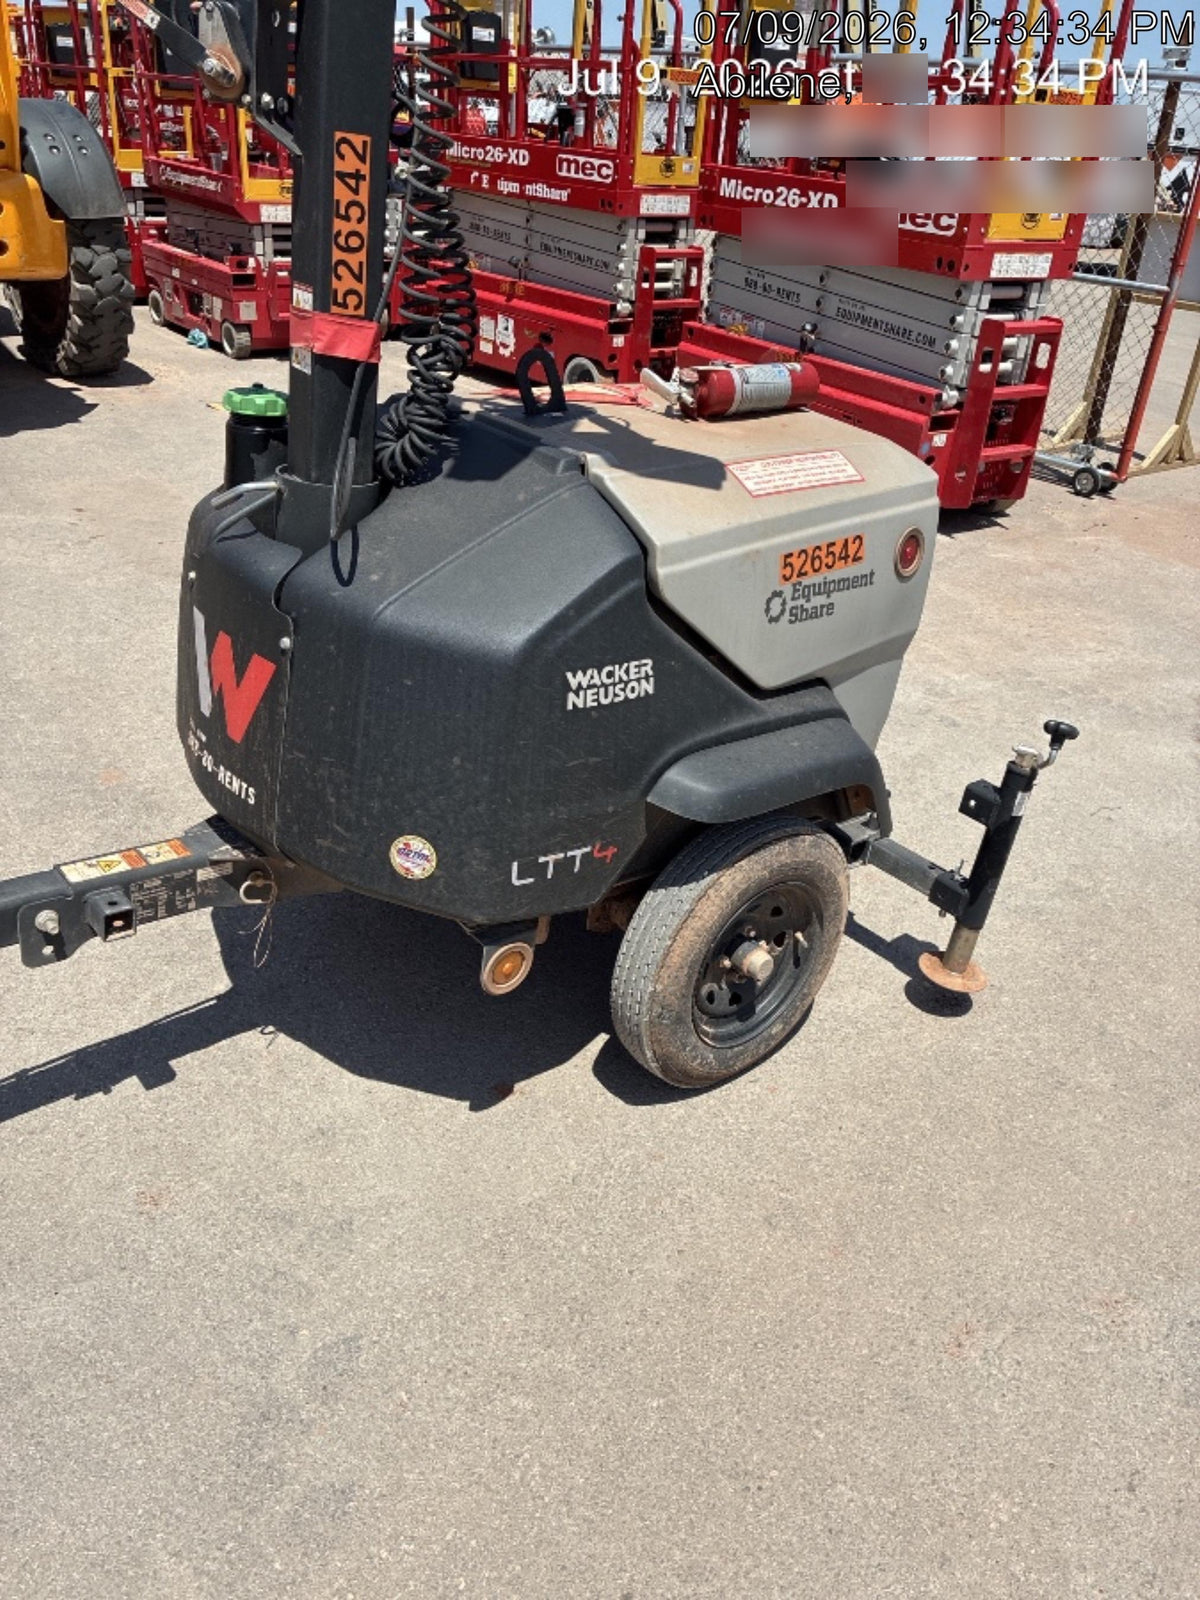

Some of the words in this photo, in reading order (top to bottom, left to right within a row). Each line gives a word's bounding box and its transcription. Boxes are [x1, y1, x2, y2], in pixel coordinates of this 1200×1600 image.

[557, 155, 613, 180] mec
[332, 135, 369, 312] 526542
[781, 533, 865, 582] 526542
[790, 569, 875, 604] Equipment
[788, 599, 835, 624] Share
[566, 658, 654, 690] WACKER
[566, 676, 655, 711] NEUSON
[511, 841, 618, 886] LTT4
